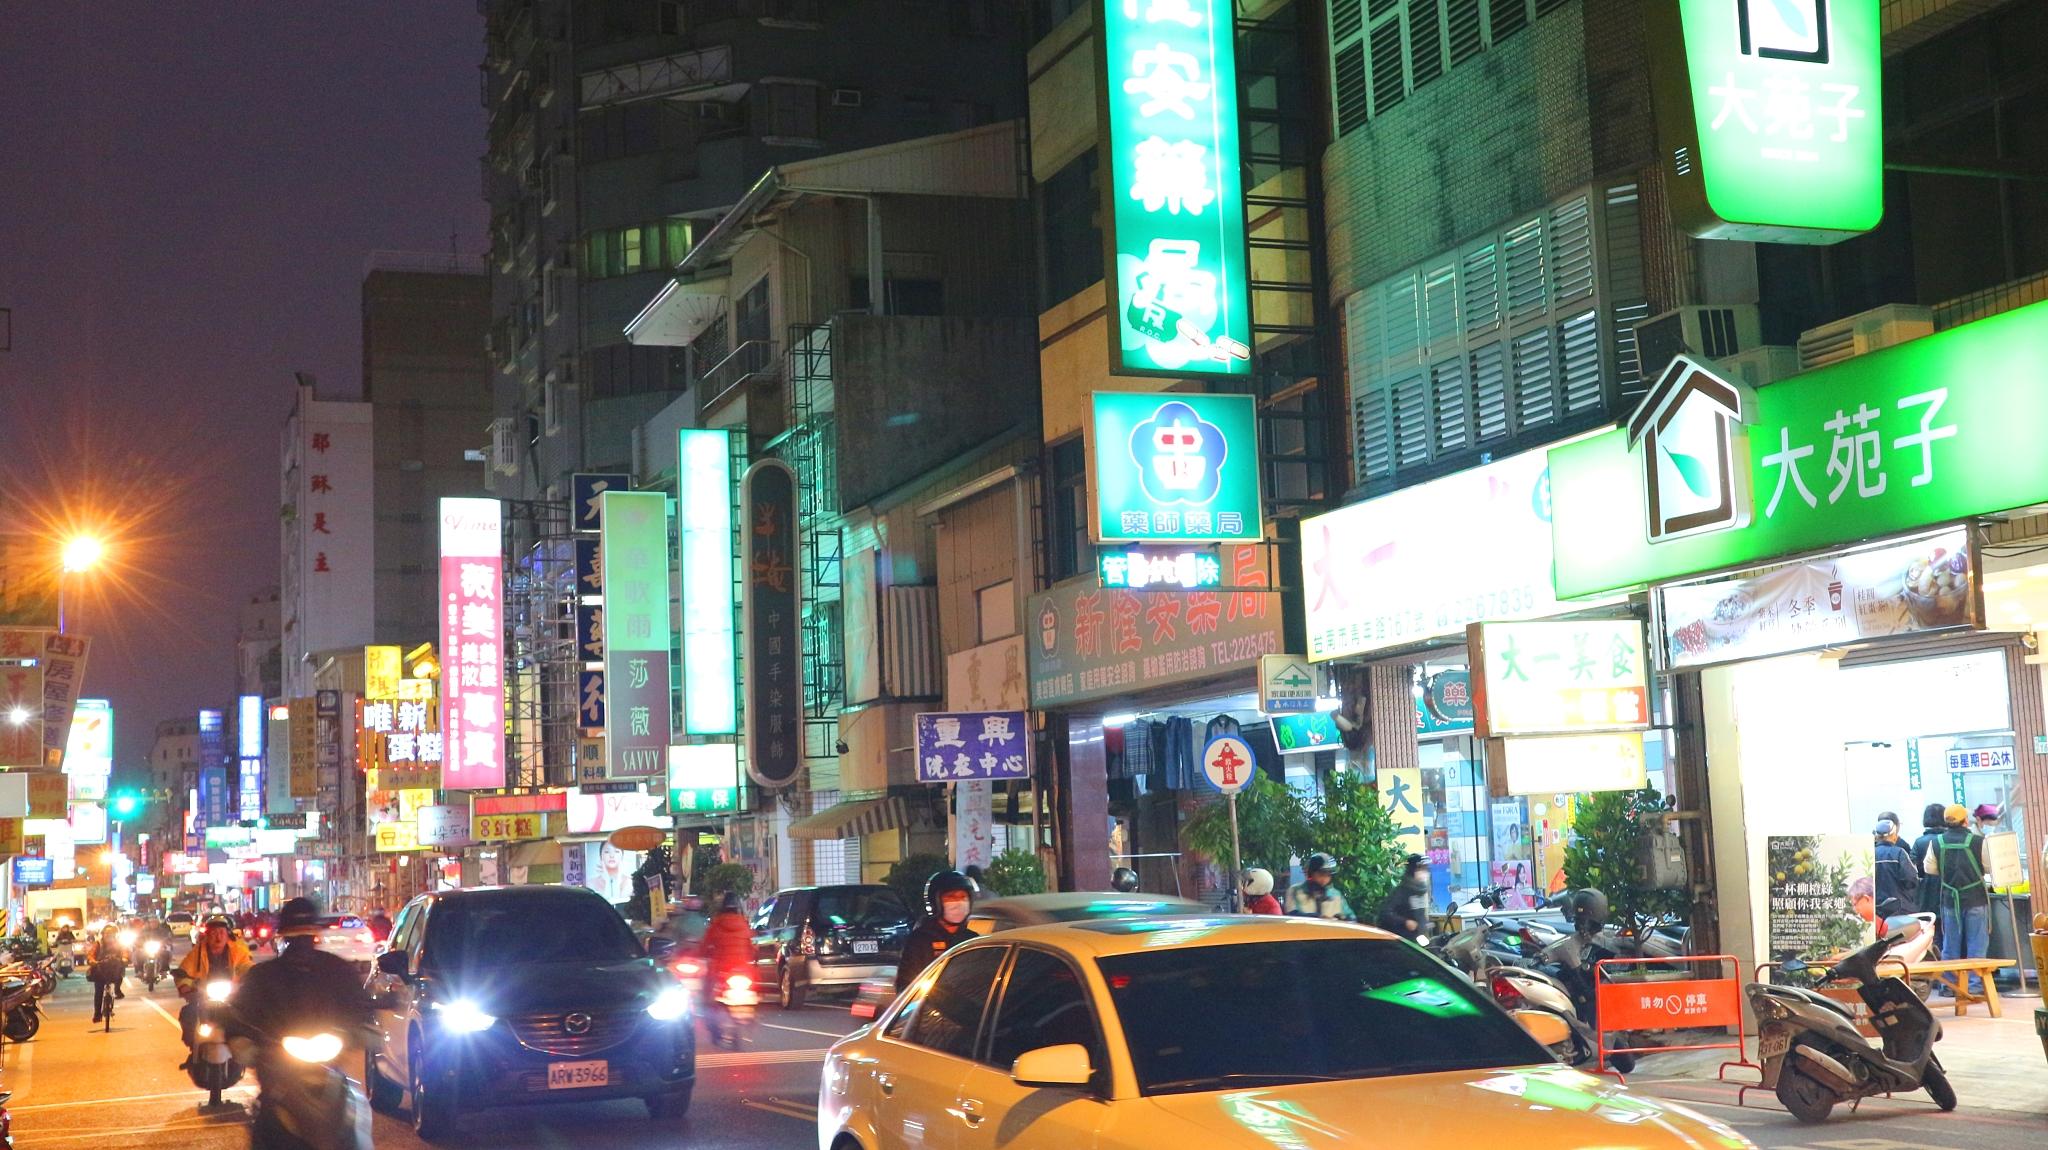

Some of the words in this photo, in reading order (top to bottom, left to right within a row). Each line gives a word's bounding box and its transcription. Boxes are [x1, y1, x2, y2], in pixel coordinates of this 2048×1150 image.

[1708, 71, 1866, 143] 大苑子
[1761, 386, 1958, 519] 大苑子
[310, 432, 333, 573] 耶穌是主
[1121, 511, 1243, 534] 藥師藥局
[1788, 595, 1817, 618] 冬季
[1500, 633, 1636, 682] 大一美食
[628, 658, 651, 737] 莎薇
[767, 609, 784, 761] 中國手染服飾
[1442, 681, 1470, 707] 藥
[364, 702, 427, 732] 唯新
[933, 716, 1016, 749] 重興
[388, 733, 443, 763] 蛋糕
[622, 749, 659, 772] SAVVY
[1949, 751, 2011, 769] 每星期日公休
[925, 750, 1024, 779] 洗衣中心
[678, 790, 730, 809] 健保
[1385, 775, 1420, 836] 大一
[493, 818, 533, 838] 蛋糕
[1772, 897, 1846, 911] 照顧你我家鄉
[1640, 995, 1664, 1009] 請勿
[1685, 992, 1707, 1007] 停車
[549, 1065, 607, 1085] ARW-3966
